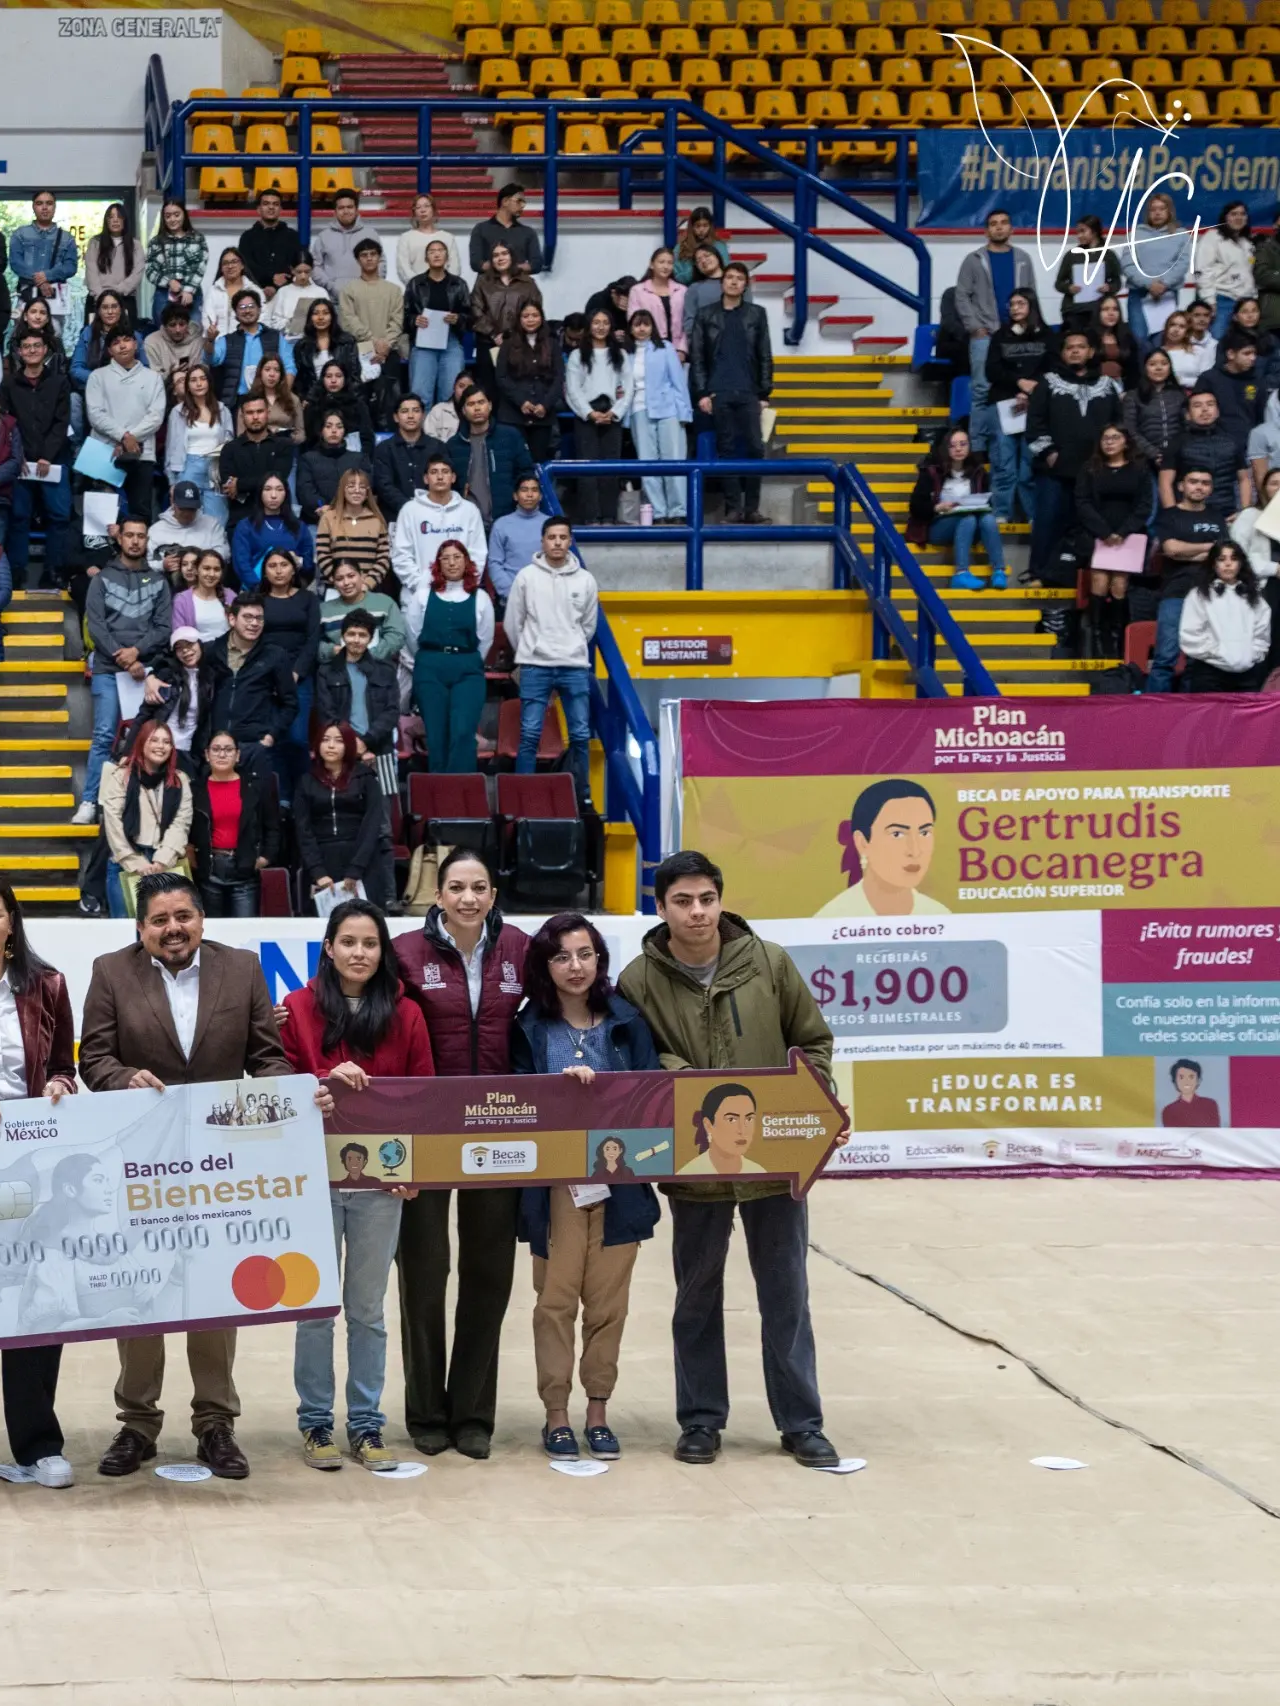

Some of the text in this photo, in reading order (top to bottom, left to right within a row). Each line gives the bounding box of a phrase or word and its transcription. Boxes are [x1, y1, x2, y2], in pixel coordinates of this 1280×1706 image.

[58, 18, 107, 37] ZONA
[660, 640, 708, 649] VESTIDOR
[661, 651, 708, 660] VISITANTE
[973, 706, 1026, 726] Plan
[935, 725, 1066, 748] Michoacán
[935, 752, 1066, 766] por la Paz y la Justicia
[958, 784, 1230, 802] BECA DE APOYO PARA TRANSPORTE
[958, 801, 1181, 842] Gertrudis
[959, 847, 1204, 890] Bocanegra
[958, 883, 1124, 900] EDUCACIÓN SUPERIOR
[832, 924, 944, 940] ¿Cuánto cobro?
[1140, 922, 1192, 942] ¡Evita
[1196, 924, 1274, 938] rumores
[856, 951, 928, 964] RECIBIRÁS
[1174, 948, 1254, 970] fraudes!
[810, 965, 969, 1012] $1,900
[1116, 994, 1280, 1008] Confía solo en la inform
[824, 1011, 962, 1025] PESOS BIMESTRALES
[1132, 1014, 1150, 1026] de
[1153, 1015, 1206, 1025] nuestra
[1208, 1012, 1257, 1028] página
[1140, 1030, 1178, 1042] redes
[1181, 1029, 1236, 1042] sociales
[844, 1043, 896, 1055] estudiante
[898, 1043, 926, 1053] hasta
[928, 1045, 944, 1054] por
[962, 1042, 1002, 1051] máximo
[1004, 1042, 1016, 1050] de
[932, 1074, 1076, 1094] ¡EDUCAR ES
[486, 1092, 516, 1104] Plan
[906, 1096, 1103, 1113] TRANSFORMAR!
[465, 1102, 538, 1116] Michoacán
[4, 1118, 57, 1129] Gobierno de
[762, 1114, 820, 1126] Gertrudis
[5, 1126, 58, 1142] México
[762, 1126, 826, 1138] Bocanegra
[492, 1150, 526, 1160] Becas
[838, 1152, 890, 1164] México
[906, 1144, 964, 1157] Educación
[124, 1152, 234, 1178] Banco del
[126, 1172, 308, 1212] Bienestar
[130, 1208, 252, 1226] El banco de los mexicanos
[62, 1231, 128, 1260] 0000
[144, 1224, 210, 1252] 0000
[226, 1216, 292, 1246] 0000
[89, 1274, 108, 1282] VALID
[110, 1268, 162, 1288] 00/00
